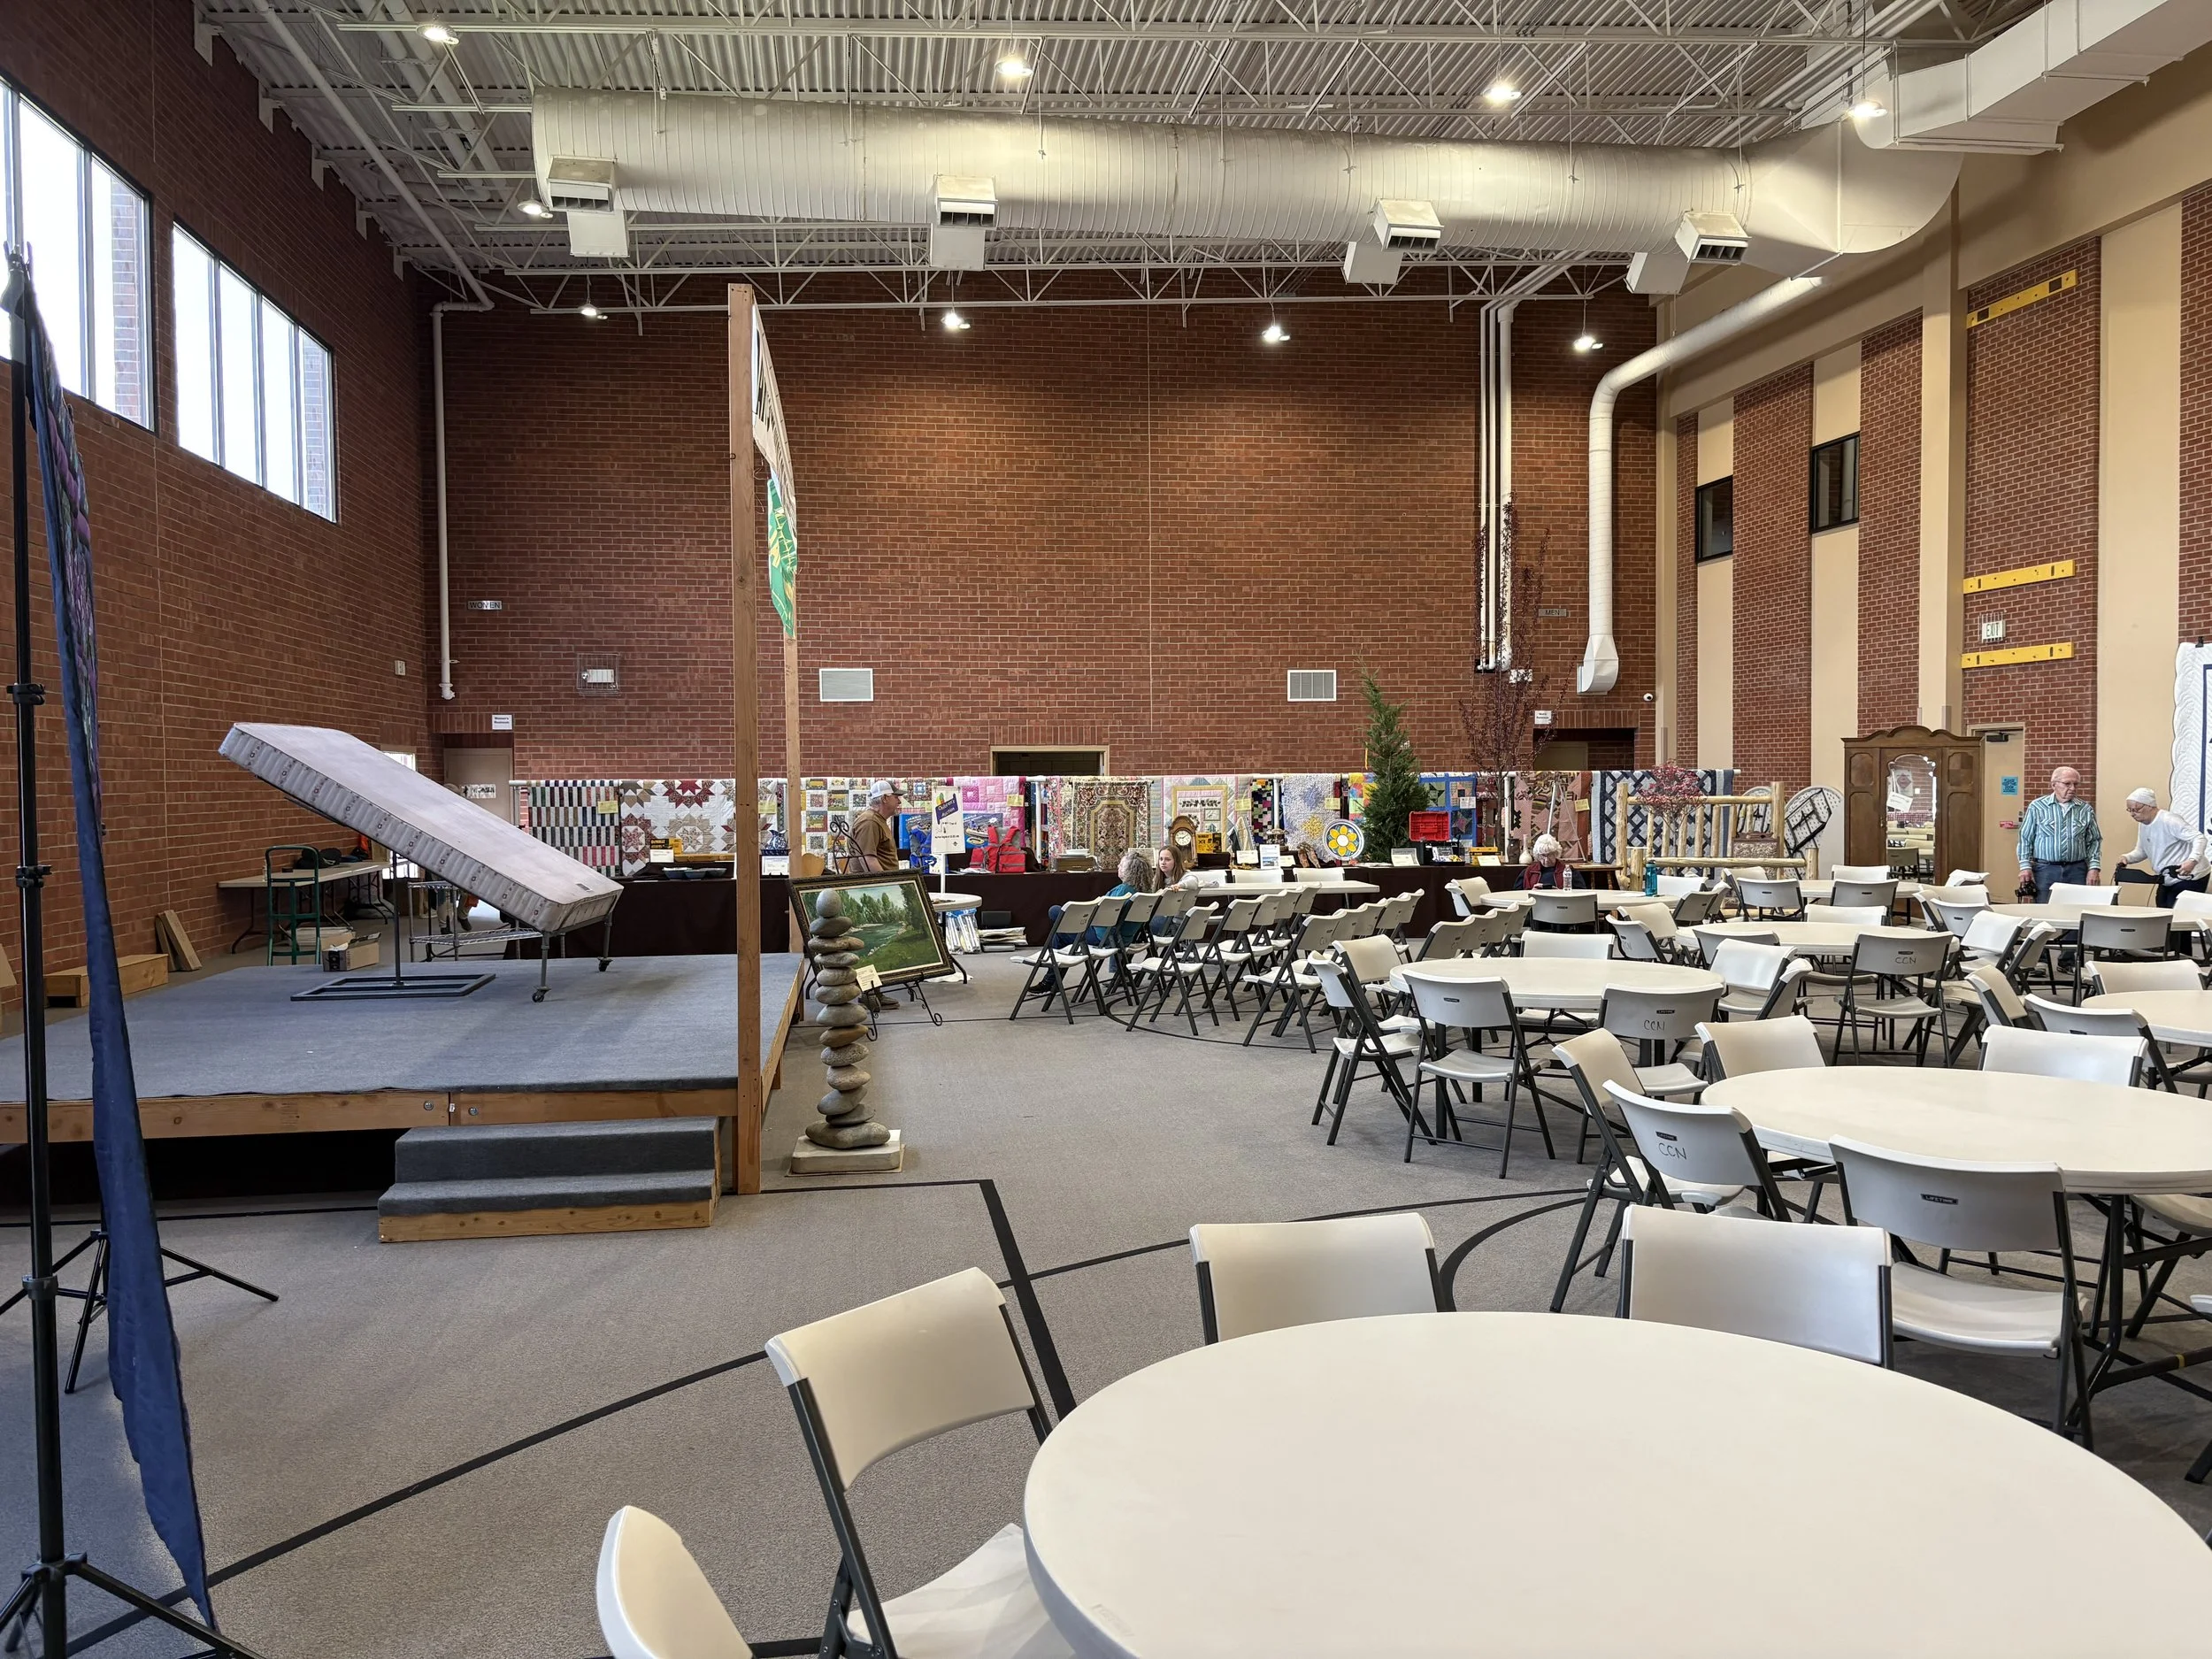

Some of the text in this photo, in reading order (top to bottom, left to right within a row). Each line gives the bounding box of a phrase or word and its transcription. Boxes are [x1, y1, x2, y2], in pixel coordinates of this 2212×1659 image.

[1986, 622, 2000, 637] EXIT
[1643, 1019, 1665, 1031] CCN
[1658, 1142, 1687, 1160] CCN
